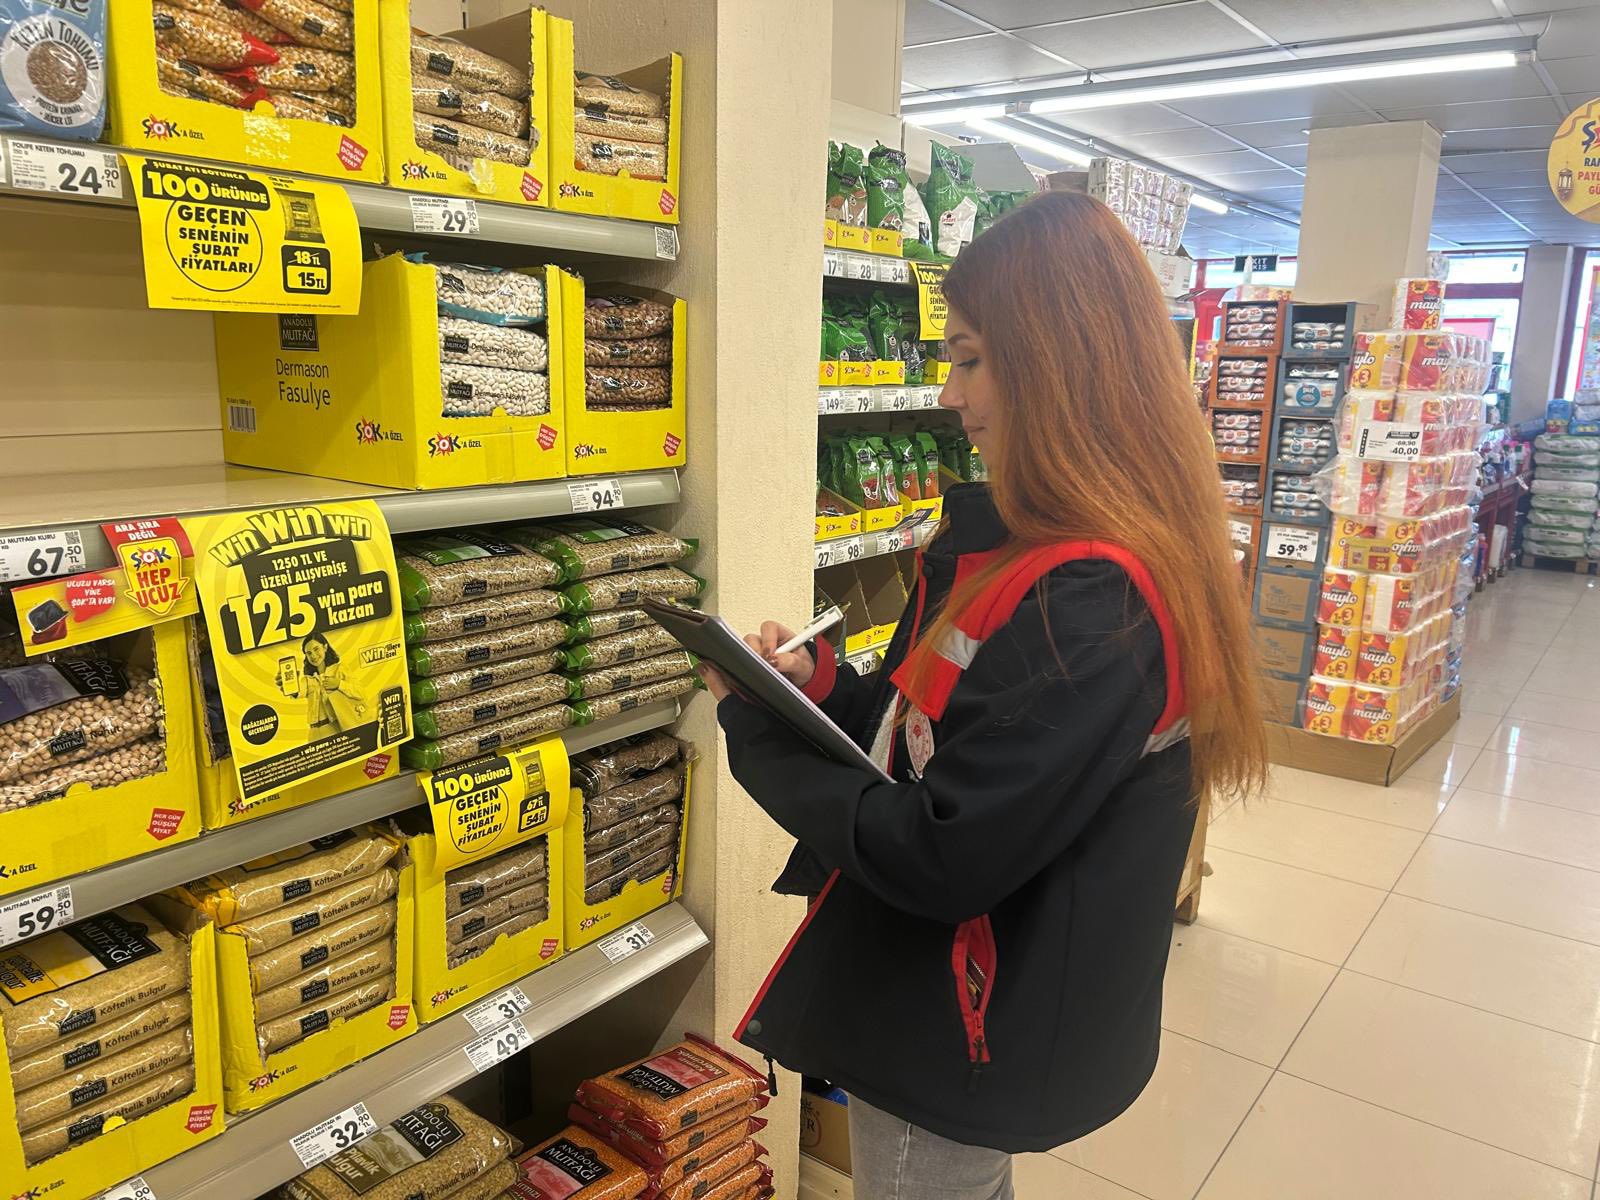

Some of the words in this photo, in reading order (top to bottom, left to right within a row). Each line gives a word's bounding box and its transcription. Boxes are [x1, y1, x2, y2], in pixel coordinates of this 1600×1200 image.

[59, 20, 100, 71] TOHUMU
[147, 171, 210, 201] 100
[211, 184, 268, 204] ÜRÜNDE
[177, 205, 246, 229] GEÇEN
[179, 227, 249, 245] SENENİN
[192, 243, 240, 258] ŞUBAT
[181, 254, 253, 275] FİYATLARI
[919, 270, 935, 284] 100
[282, 317, 314, 328] ANADOLU
[282, 327, 316, 343] MUTFAĞI
[276, 358, 330, 379] Dermason
[279, 380, 331, 410] Fasulye
[858, 397, 869, 412] 79
[893, 396, 905, 410] 49
[114, 523, 135, 533] ARA
[128, 531, 157, 542] DEĞİL
[272, 557, 299, 571] 1250
[300, 553, 313, 566] TL
[314, 551, 328, 563] VE
[848, 544, 859, 559] 98
[136, 567, 171, 588] HEP
[261, 570, 292, 590] ÜZERİ
[295, 559, 348, 584] ALIŞVERİŞE
[135, 582, 182, 610] UCUZ
[318, 589, 346, 608] win
[349, 578, 384, 602] para
[1322, 590, 1358, 608] maylo
[227, 583, 317, 651] 125
[327, 603, 375, 626] kazan
[1318, 643, 1351, 660] maylo
[1360, 651, 1396, 667] maylo
[1353, 707, 1392, 724] maylo
[90, 726, 121, 739] Nohut
[434, 773, 474, 800] 100
[474, 766, 511, 785] ÜRÜNDE
[456, 787, 499, 811] GEÇEN
[458, 802, 502, 825] SENENİN
[152, 820, 178, 829] DÜŞÜK
[153, 827, 172, 835] FİYAT
[466, 815, 495, 833] ŞUBAT
[458, 823, 503, 846] FİYATLARI
[18, 863, 38, 874] ÖZEL
[314, 872, 343, 887] Köftelik
[31, 891, 53, 903] NOHUT
[322, 903, 350, 920] Köftelik
[330, 936, 358, 953] Köftelik
[332, 970, 359, 988] Köftelik
[359, 963, 381, 976] Bulgur
[100, 996, 136, 1016] Köftelik
[138, 983, 167, 1001] Bulgur
[105, 1028, 142, 1049] Köftelik
[143, 1016, 170, 1033] Bulgur
[111, 1066, 148, 1087] Köftelik
[149, 1053, 178, 1071] Bulgur
[631, 1068, 680, 1095] MUTFAĞI
[146, 1088, 175, 1106] Bulgur
[545, 1147, 596, 1181] MUTFAĞI
[560, 1143, 602, 1173] ANADOLU
